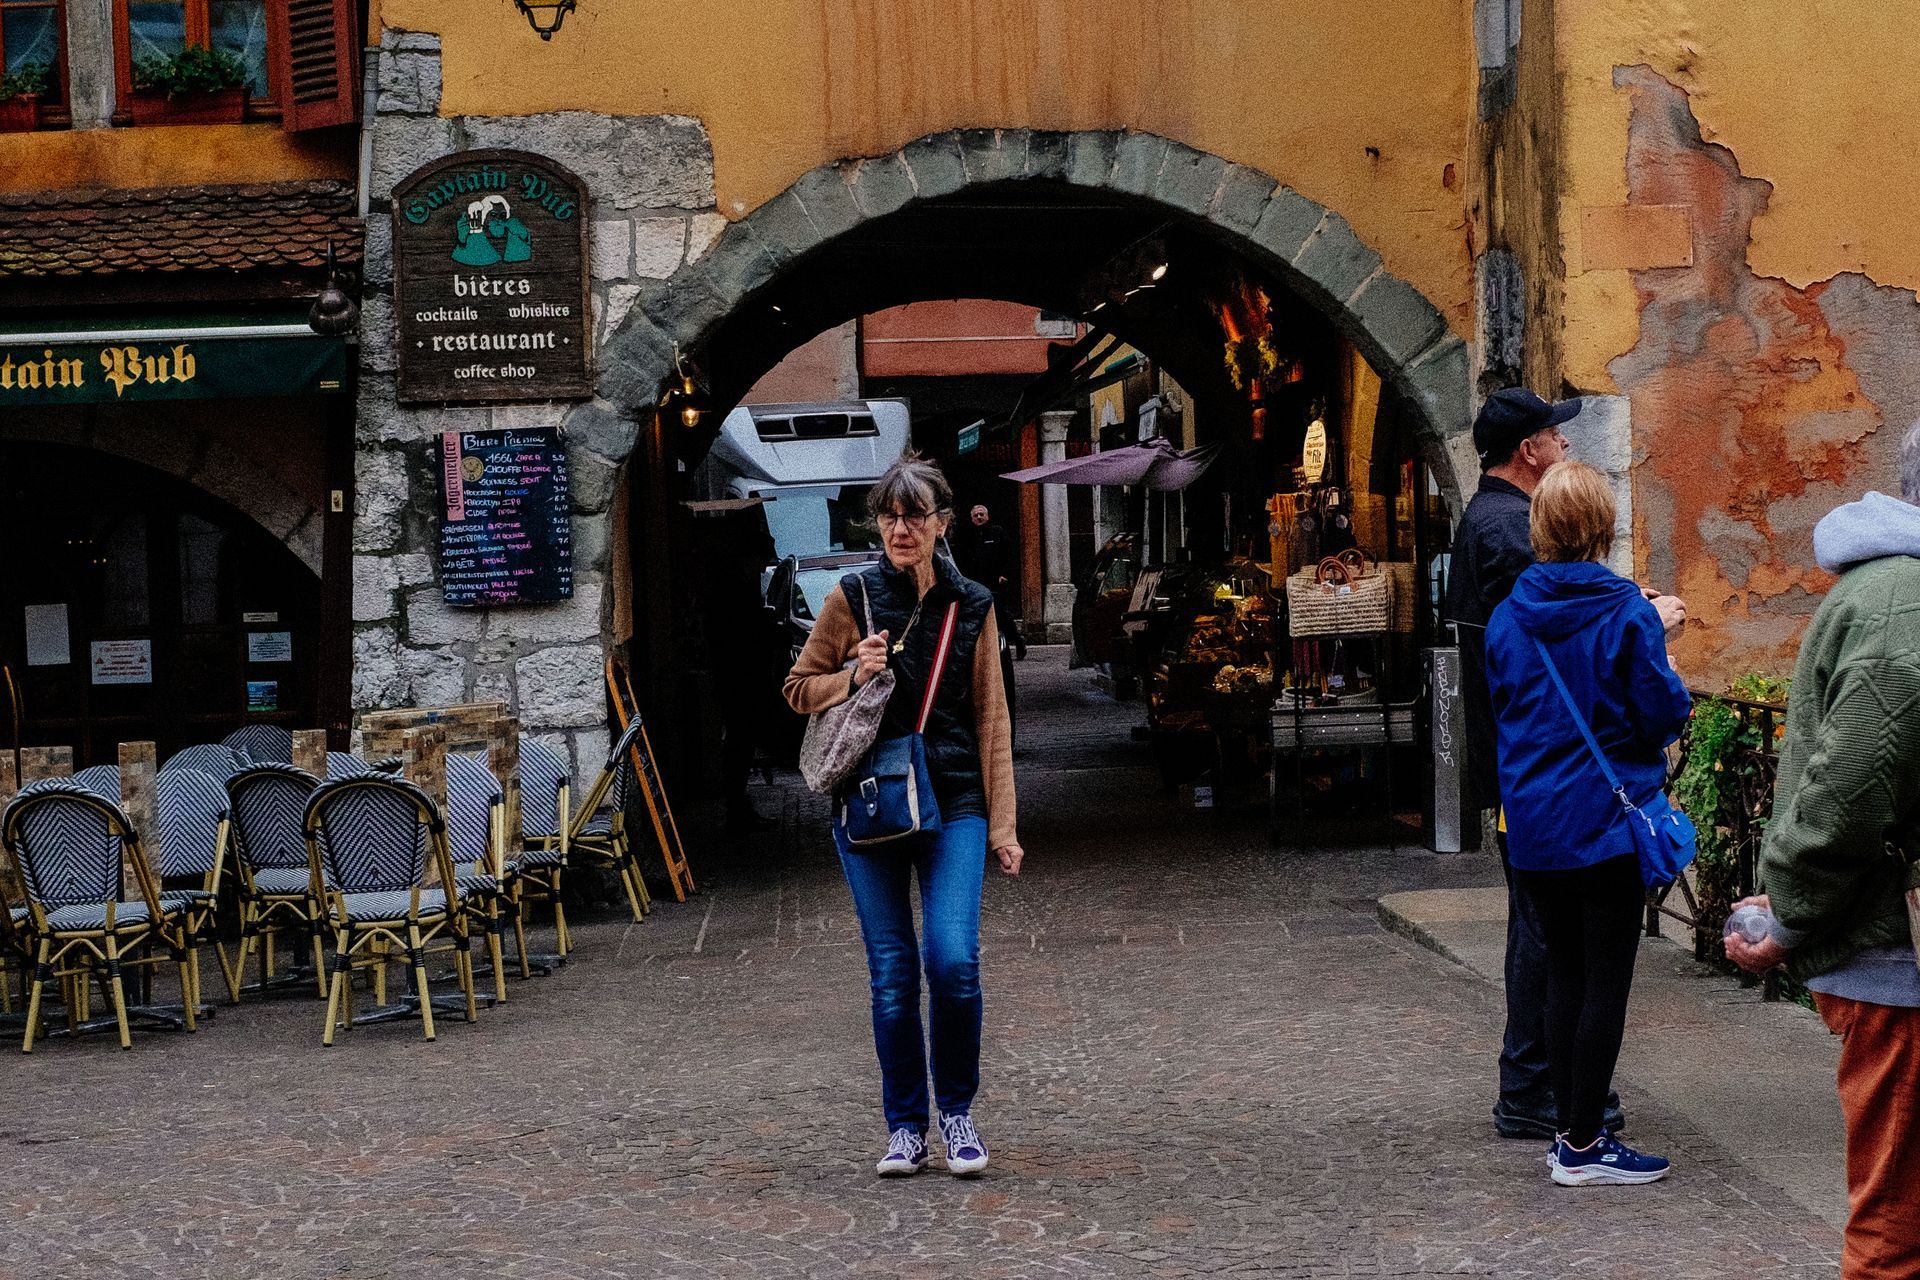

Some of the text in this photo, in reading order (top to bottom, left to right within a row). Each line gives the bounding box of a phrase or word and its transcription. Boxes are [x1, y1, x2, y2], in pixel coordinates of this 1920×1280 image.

[404, 165, 577, 224] Captain Pub
[453, 274, 531, 297] bières
[415, 303, 570, 322] cocktails whiskies
[432, 330, 556, 351] restaurant
[0, 343, 196, 398] tain Pub
[454, 363, 536, 379] coffee shop
[488, 453, 512, 464] 1664
